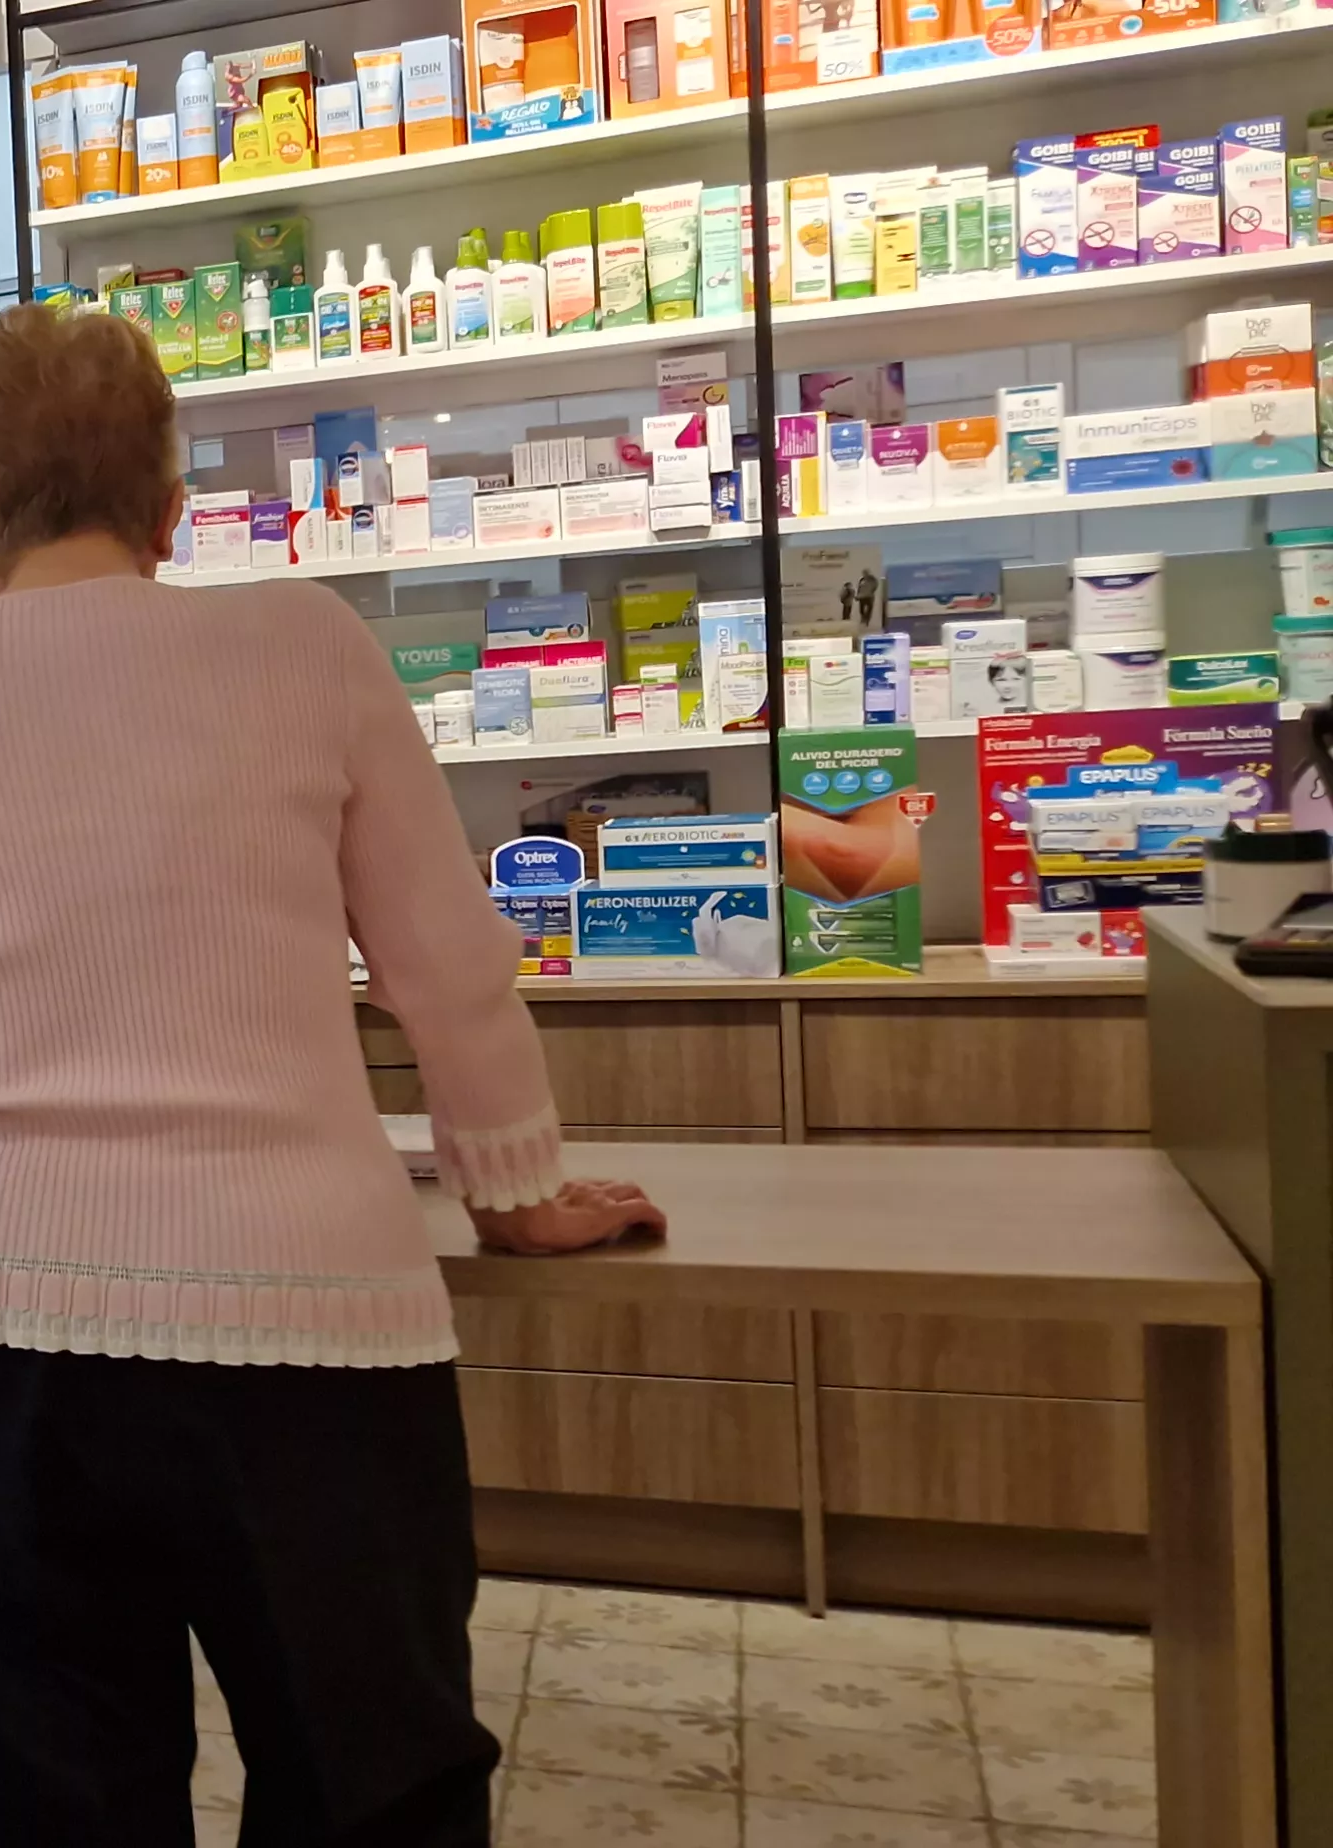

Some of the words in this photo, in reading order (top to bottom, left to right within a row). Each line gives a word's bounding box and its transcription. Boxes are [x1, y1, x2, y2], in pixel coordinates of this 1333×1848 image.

[409, 62, 442, 76] ISDIN
[822, 60, 864, 78] 50%
[85, 102, 114, 114] ISDIN
[183, 95, 209, 107] ISDIN
[38, 110, 59, 125] ISDIN
[272, 110, 294, 121] ISDIN
[500, 101, 550, 122] REGALO
[1235, 122, 1282, 139] GOIBI
[1030, 142, 1075, 158] GOIBI
[1088, 149, 1133, 166] GOIBI
[1169, 144, 1215, 161] GOIBI
[145, 167, 171, 182] 20%
[1174, 172, 1214, 187] GOIBI
[642, 198, 694, 214] RepelBite
[120, 292, 142, 305] Relec
[162, 286, 184, 299] Relec
[1007, 407, 1057, 421] BIOTIC
[1078, 415, 1198, 439] Inmunicaps
[195, 512, 241, 524] Femibiotic
[396, 648, 453, 665] YOVIS
[1227, 725, 1273, 740] Sueño
[790, 751, 831, 761] ALIVIO
[833, 748, 903, 760] DURADERO
[816, 759, 839, 769] DEL
[841, 758, 879, 768] PICOR
[1079, 766, 1159, 784] EPAPLUS
[1047, 811, 1119, 825] EPAPLUS
[1141, 805, 1215, 819] EPAPLUS
[514, 851, 560, 867] Optrex
[584, 896, 697, 909] AERONEBULIZER
[584, 913, 629, 933] family
